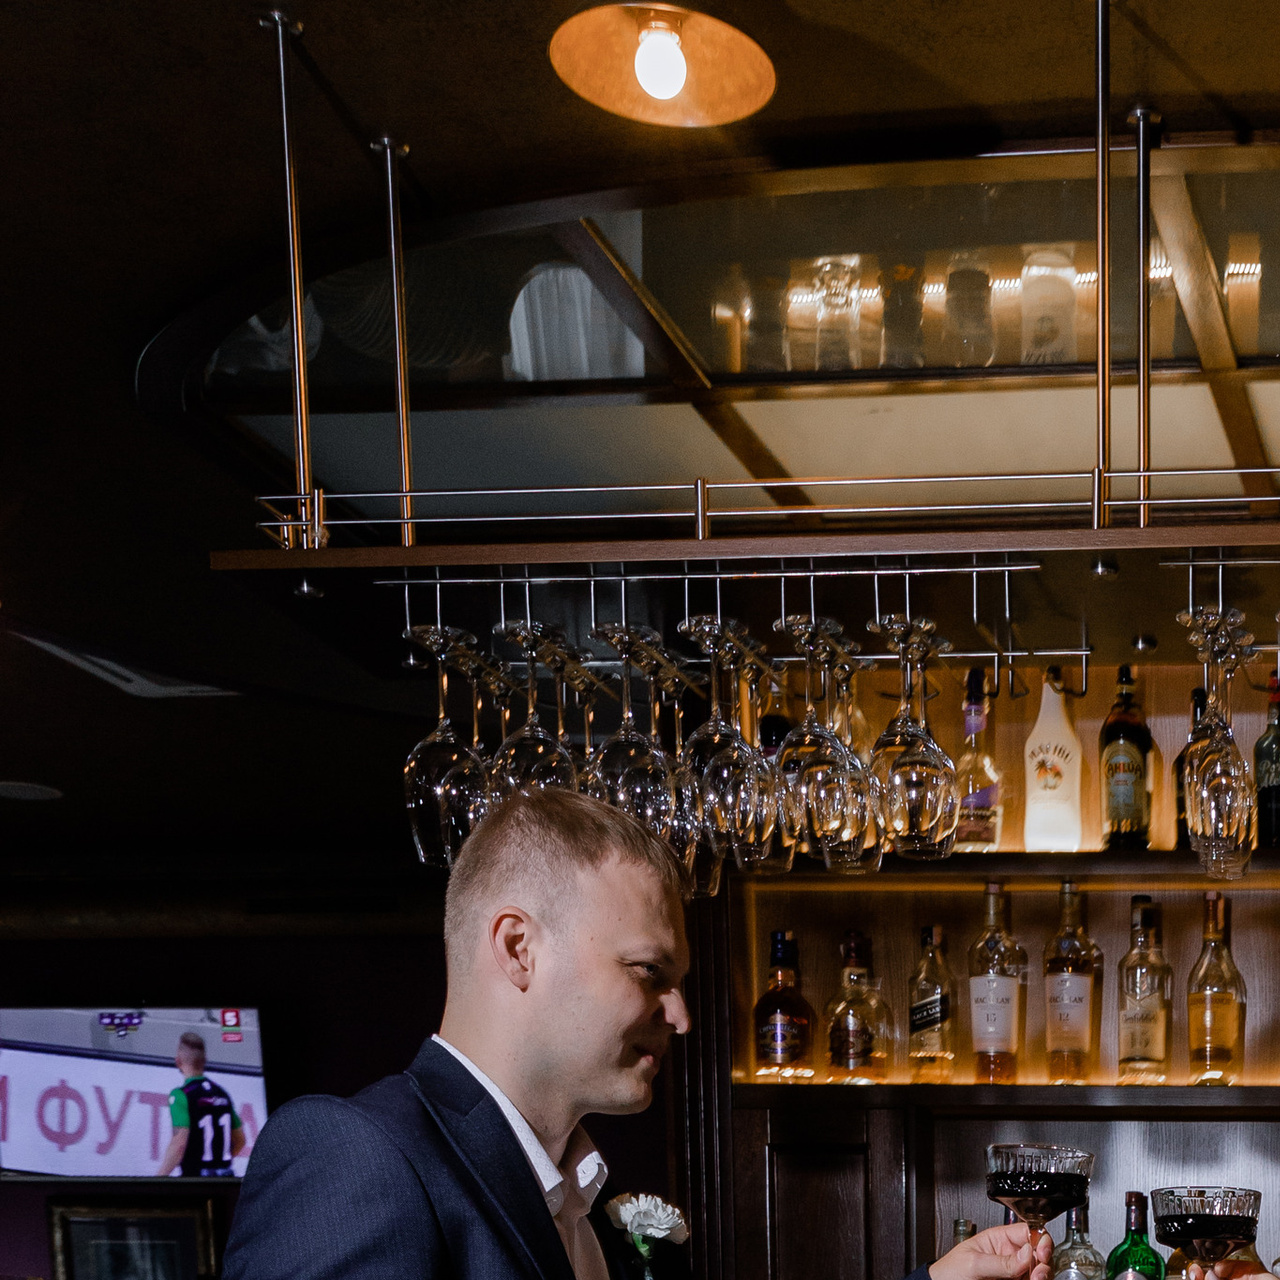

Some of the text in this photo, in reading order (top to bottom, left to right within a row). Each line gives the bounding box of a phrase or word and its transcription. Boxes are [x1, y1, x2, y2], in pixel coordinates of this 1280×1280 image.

[974, 997, 1011, 1005] MACLAN
[1048, 996, 1085, 1004] MACLAN
[198, 1113, 232, 1162] 11
